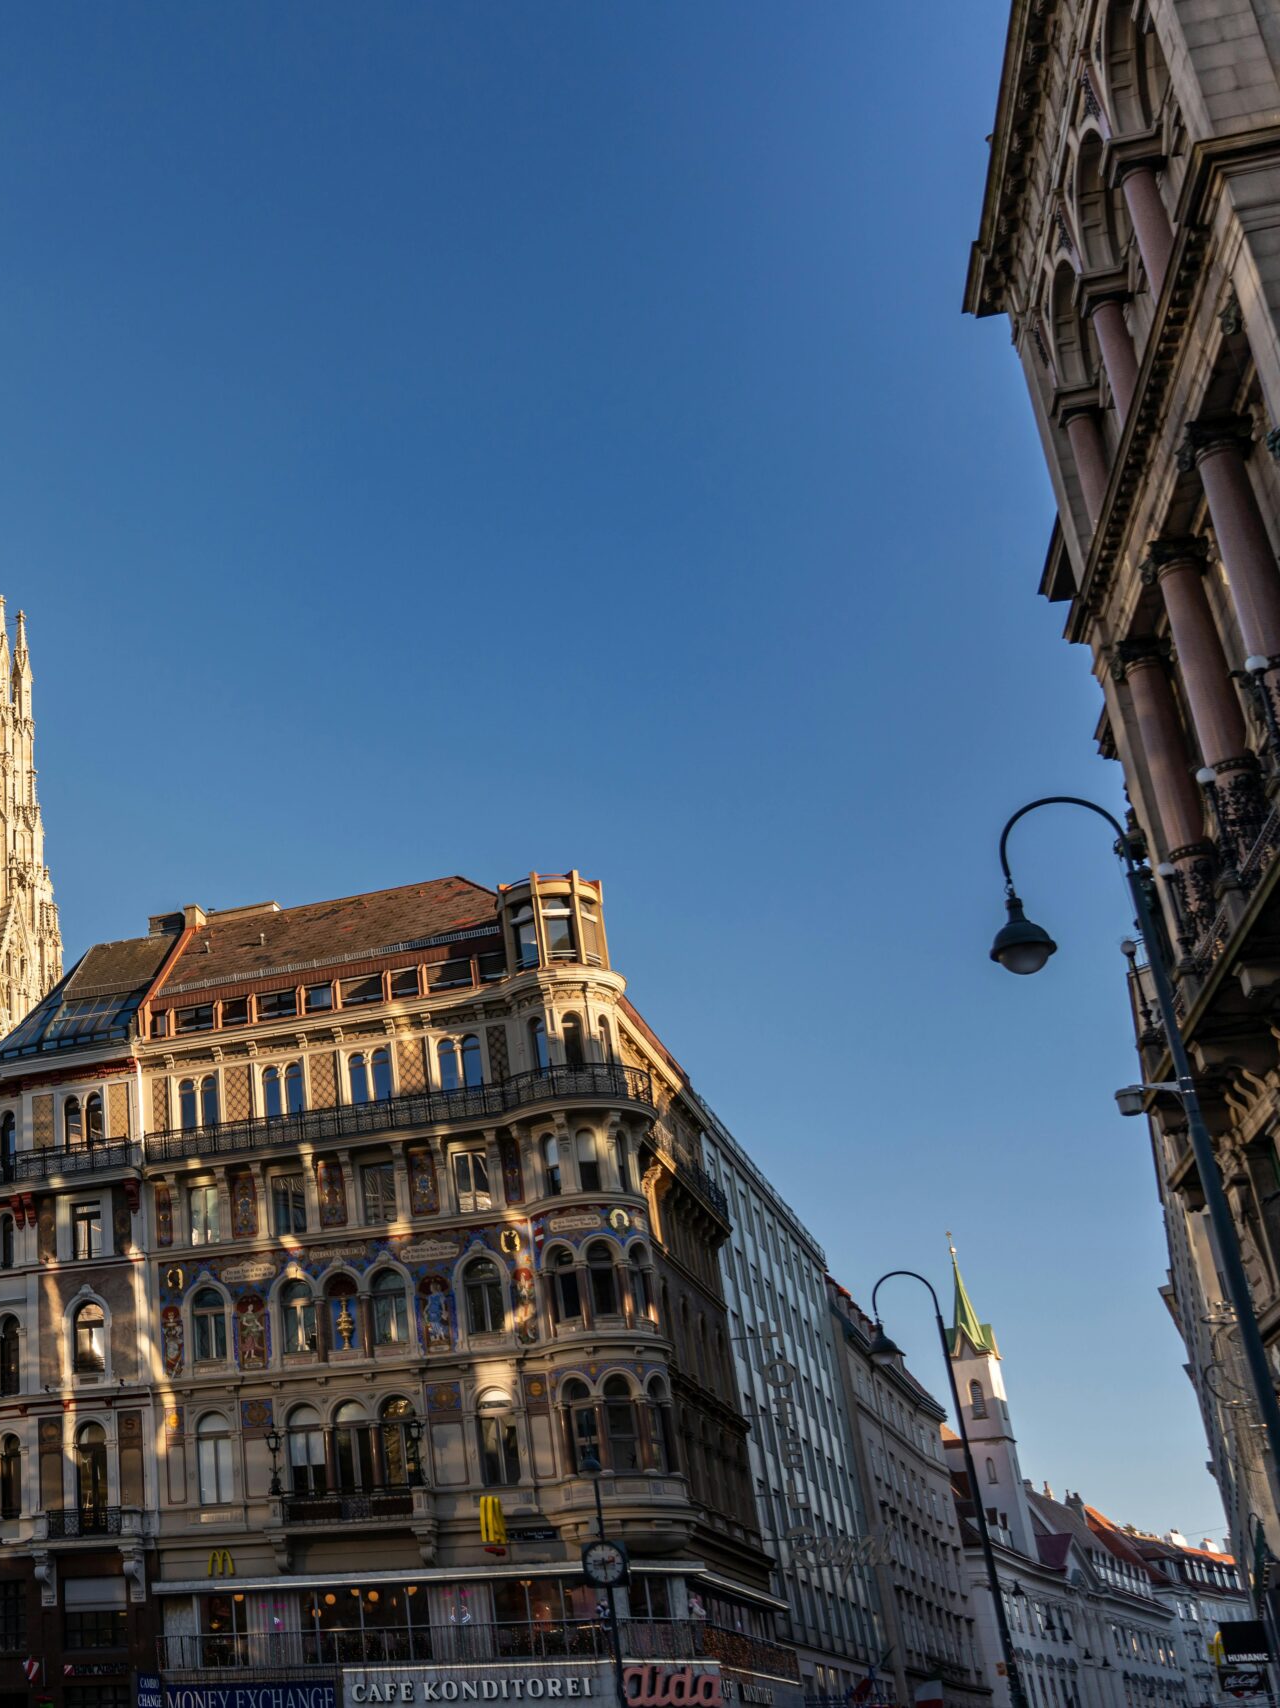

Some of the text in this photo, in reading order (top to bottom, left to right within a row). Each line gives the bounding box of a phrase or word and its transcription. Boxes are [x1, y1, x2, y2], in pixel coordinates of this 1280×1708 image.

[760, 1321, 812, 1510] HOTEL
[786, 1522, 895, 1585] Royal
[1227, 1653, 1269, 1662] HUMANIC
[166, 1687, 334, 1708] MONEY EXCHANGE
[423, 1677, 592, 1700] KONDITOREI
[138, 1693, 163, 1707] CHANGE
